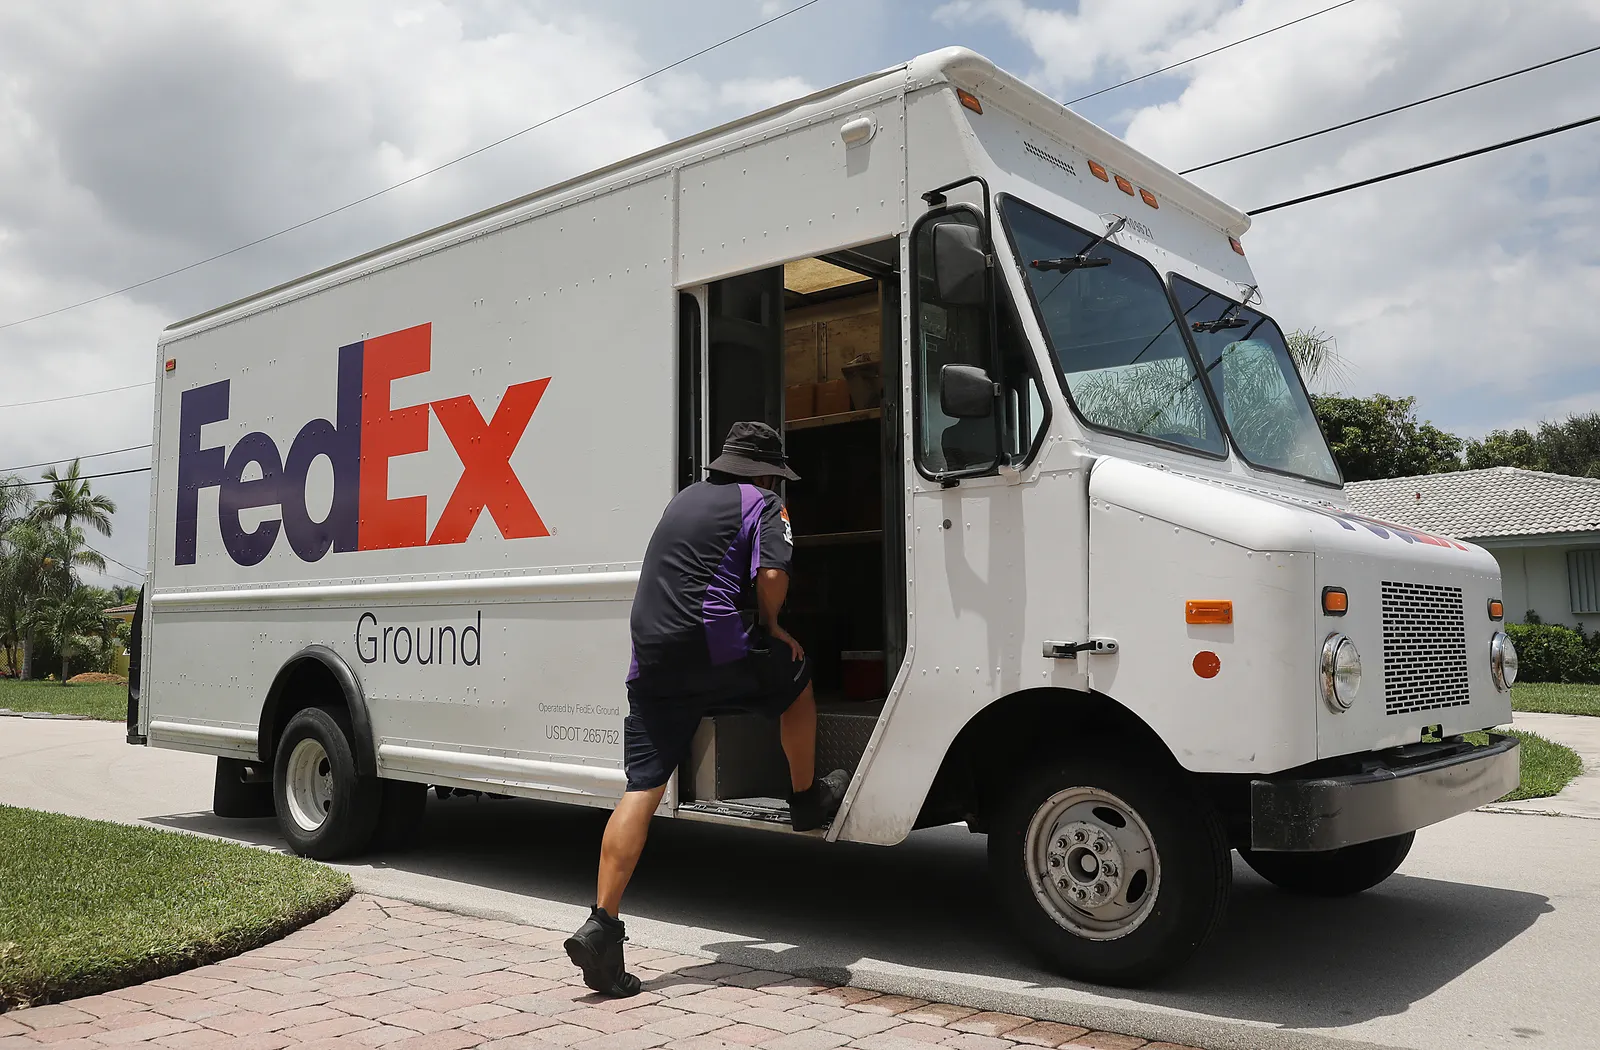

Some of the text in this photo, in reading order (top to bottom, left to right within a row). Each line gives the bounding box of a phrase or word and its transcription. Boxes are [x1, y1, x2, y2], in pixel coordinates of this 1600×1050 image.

[174, 321, 552, 567] FedEx
[356, 610, 481, 666] Ground
[538, 702, 620, 716] Operated by FedEx Ground
[545, 724, 620, 745] USDOT 265752
